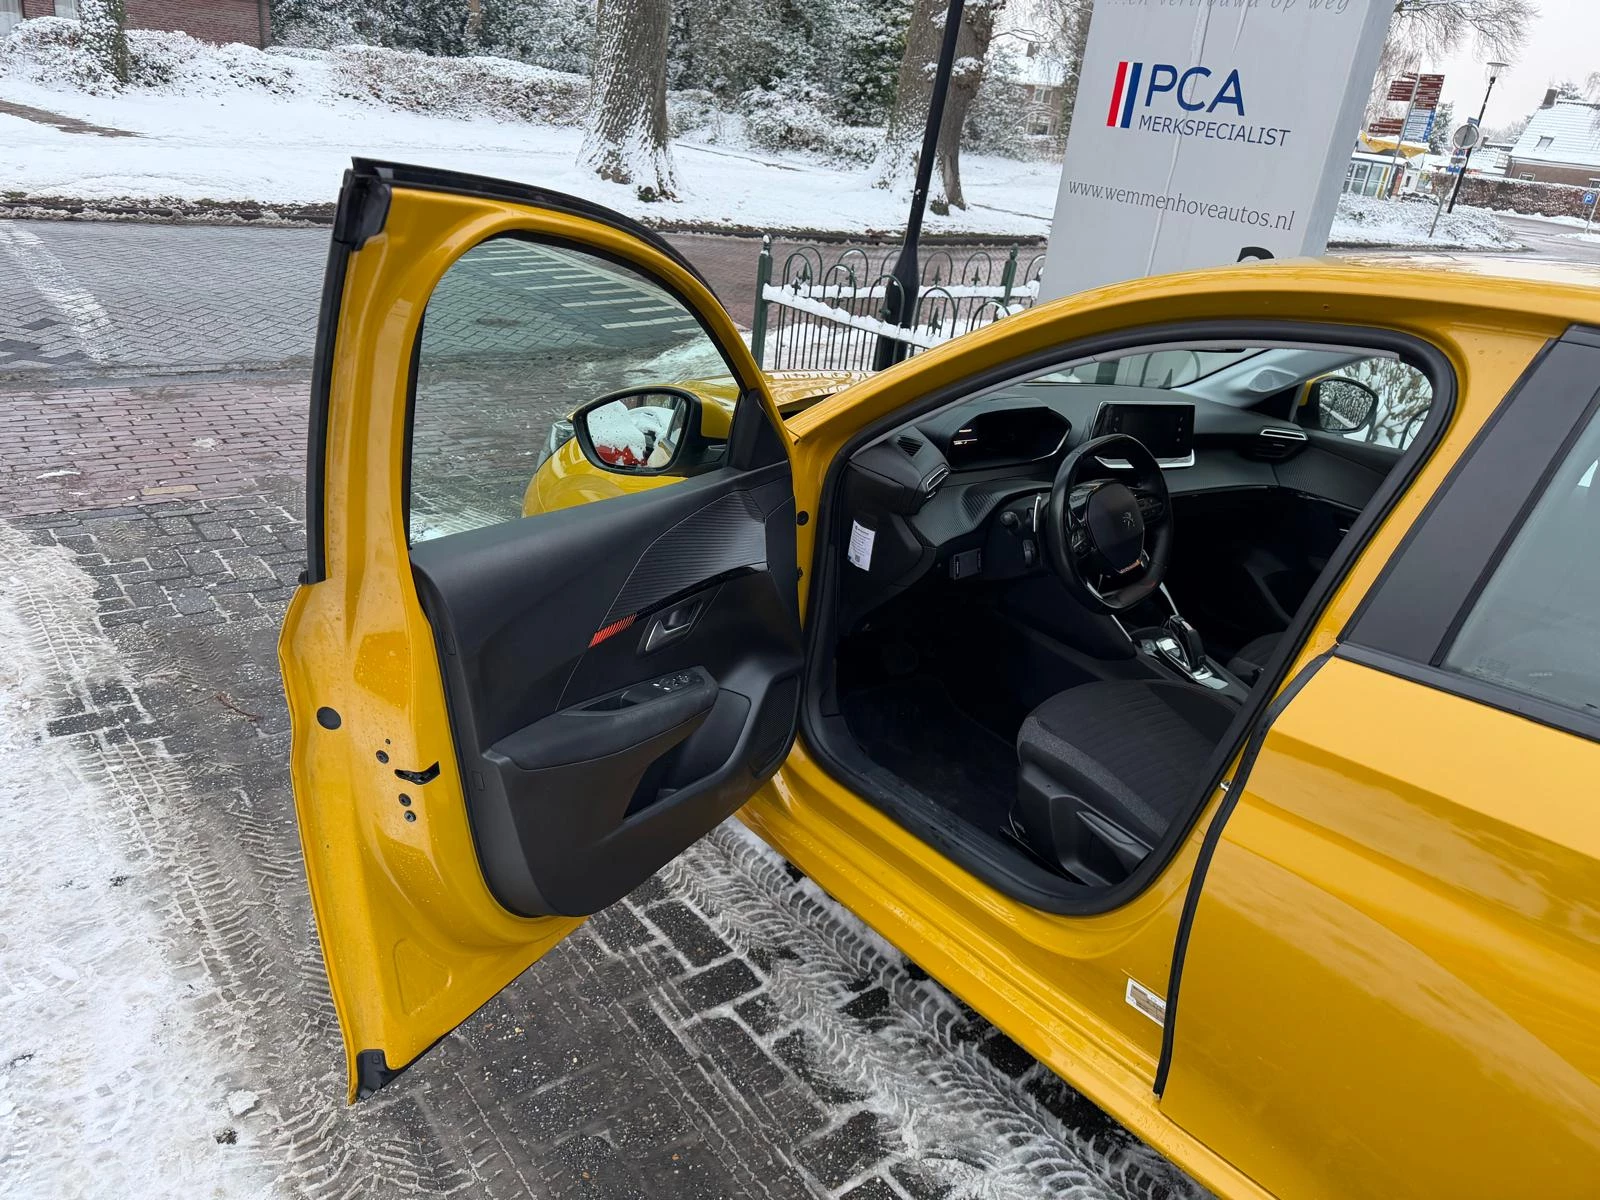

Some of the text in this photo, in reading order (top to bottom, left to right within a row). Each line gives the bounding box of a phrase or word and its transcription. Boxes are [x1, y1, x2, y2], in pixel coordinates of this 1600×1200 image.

[1145, 64, 1245, 116] PCA
[1138, 114, 1291, 147] MERKSPECIALIST
[1068, 180, 1296, 231] www.wemmenhoveautos.nl
